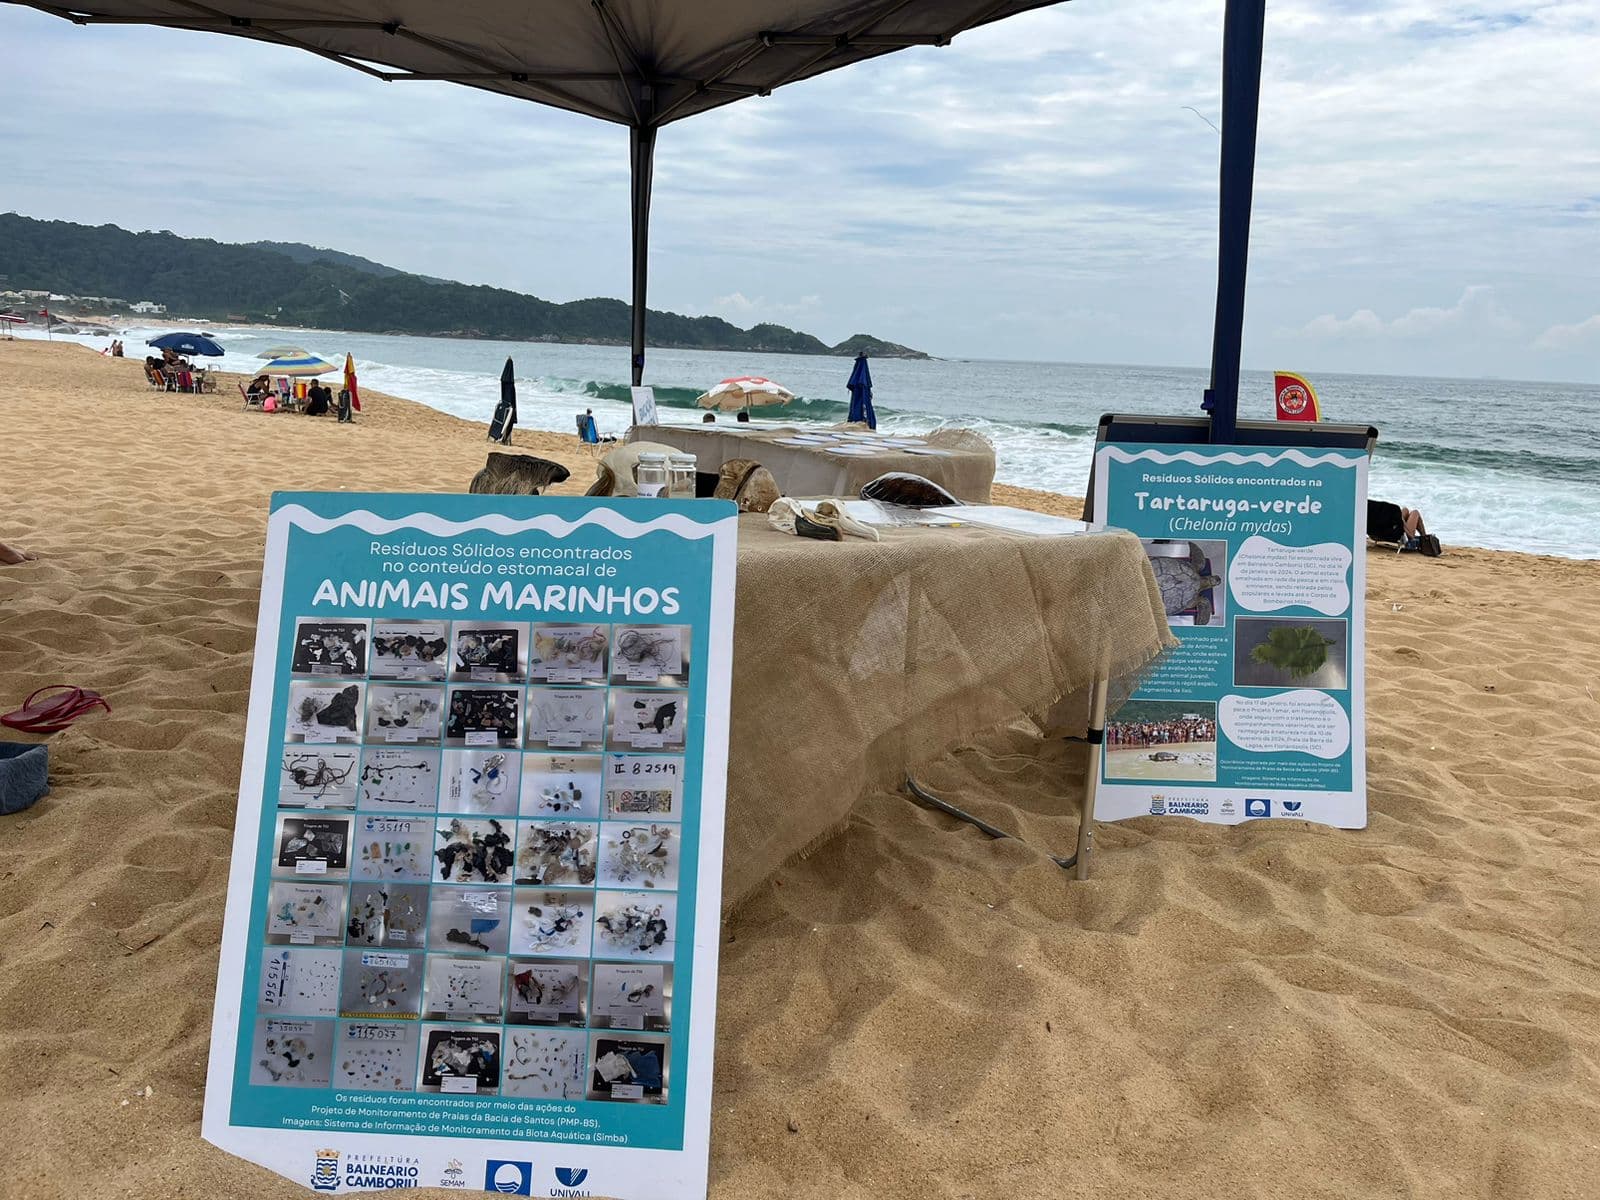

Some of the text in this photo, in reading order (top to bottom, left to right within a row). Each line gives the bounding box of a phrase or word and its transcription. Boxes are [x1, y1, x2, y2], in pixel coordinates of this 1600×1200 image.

[1142, 474, 1191, 483] Resíduos
[1194, 474, 1234, 484] Sólidos
[1236, 476, 1306, 486] encontrados
[1134, 492, 1322, 518] Tartaruga-verde
[1169, 517, 1292, 535] (Chelonia mydas)
[370, 540, 631, 560] Resíduos Sólidos encontrados
[383, 560, 616, 577] no conteúdo estomacal de
[312, 579, 680, 614] ANIMAIS MARINHOS
[336, 1094, 575, 1114] Os resíduos foram encontrados por meio das ações do
[311, 1105, 600, 1129] Projeto de Monitoramento de Praias da Bacia de Santos (PMP-BS).
[283, 1116, 627, 1143] Imagens: Sistema de Informação de Monitoramento da Biota Aquática (Simba)
[347, 1154, 419, 1164] PREFEITURA
[440, 1179, 465, 1187] SEMAM
